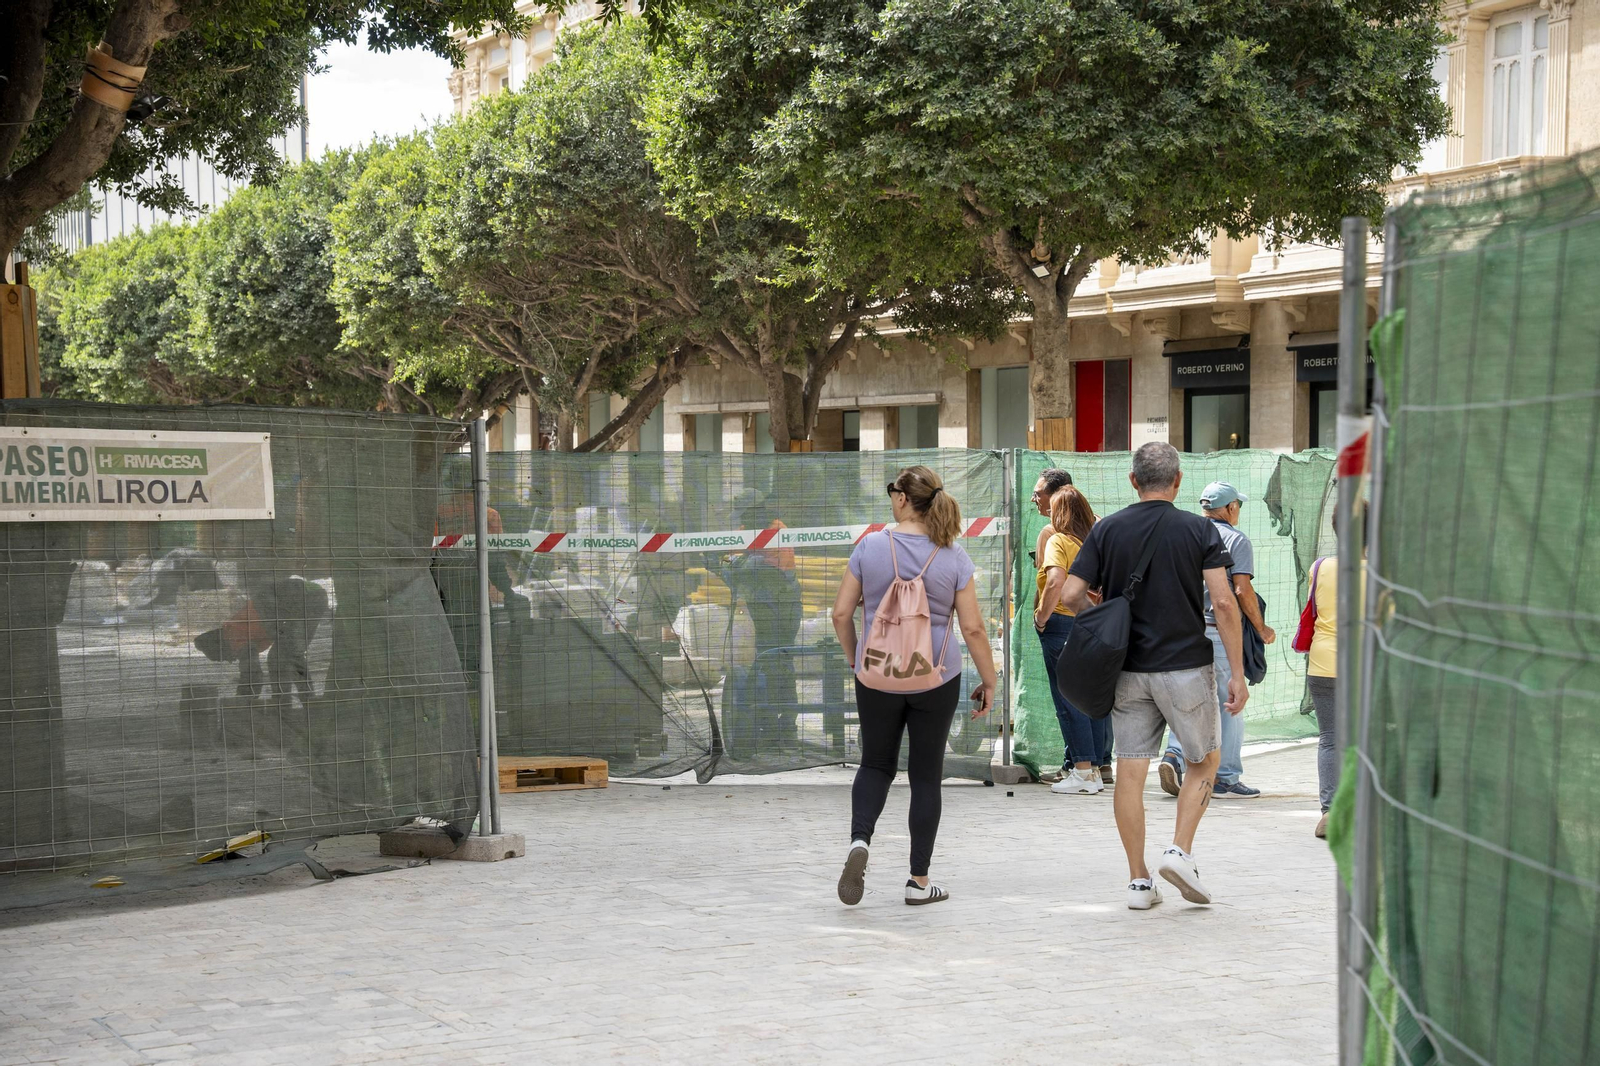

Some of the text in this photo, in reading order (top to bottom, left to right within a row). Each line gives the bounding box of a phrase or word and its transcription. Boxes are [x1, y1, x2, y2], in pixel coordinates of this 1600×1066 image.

[1177, 362, 1245, 375] ROBERTO VERINO
[0, 445, 89, 477] ASEO
[0, 476, 91, 504] LMERÍA
[97, 479, 209, 504] LIROLA
[464, 538, 532, 548] HMACESA
[864, 647, 932, 679] FILA
